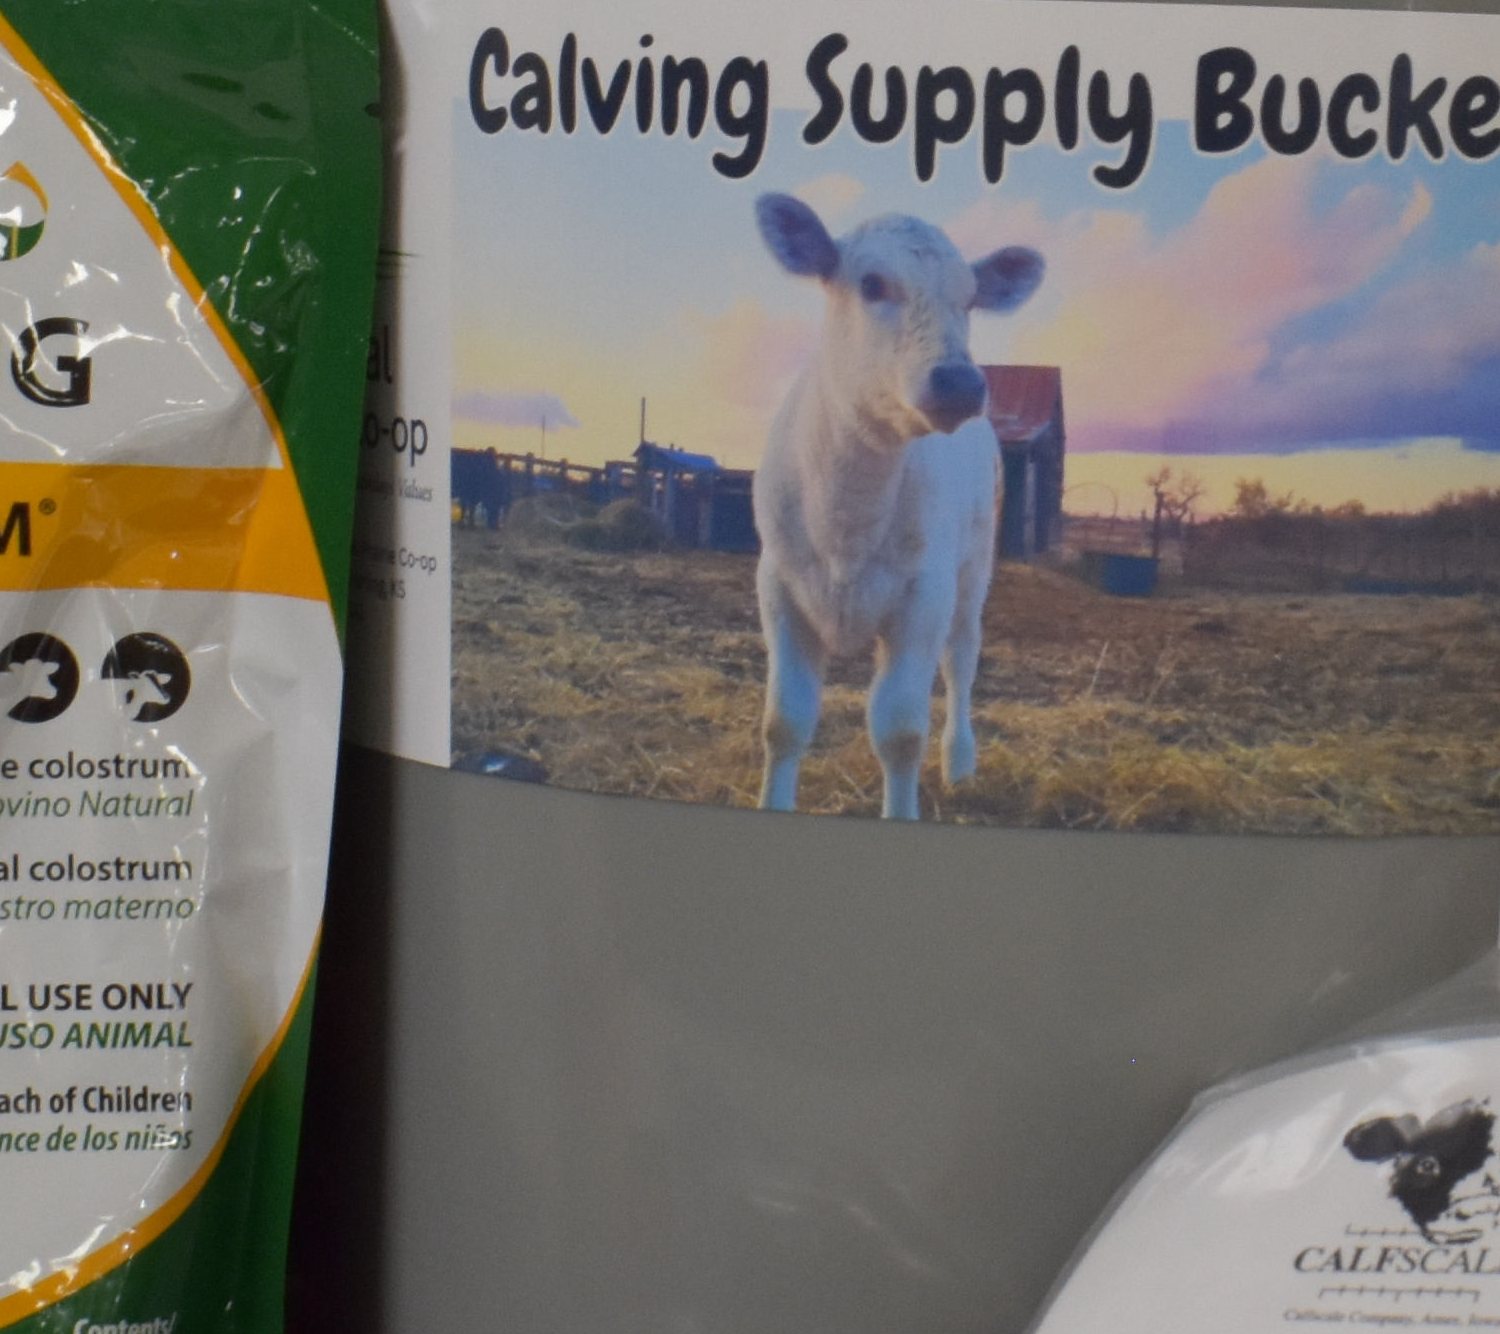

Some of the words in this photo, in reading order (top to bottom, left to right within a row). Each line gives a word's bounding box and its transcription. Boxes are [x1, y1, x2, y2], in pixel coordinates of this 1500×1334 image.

[469, 26, 769, 179] Calving
[801, 31, 1152, 190] Supply
[362, 411, 429, 468] o-op
[28, 751, 191, 782] colostrum
[79, 790, 193, 818] Natural
[29, 854, 193, 884] colostrum
[65, 896, 195, 921] materno
[28, 984, 93, 1012] USE
[101, 983, 193, 1012] ONLY
[62, 1021, 193, 1050] ANIMAL
[48, 1086, 79, 1114] of
[84, 1086, 193, 1114] Children
[46, 1125, 77, 1152] de
[84, 1125, 119, 1152] los
[125, 1123, 193, 1150] niños
